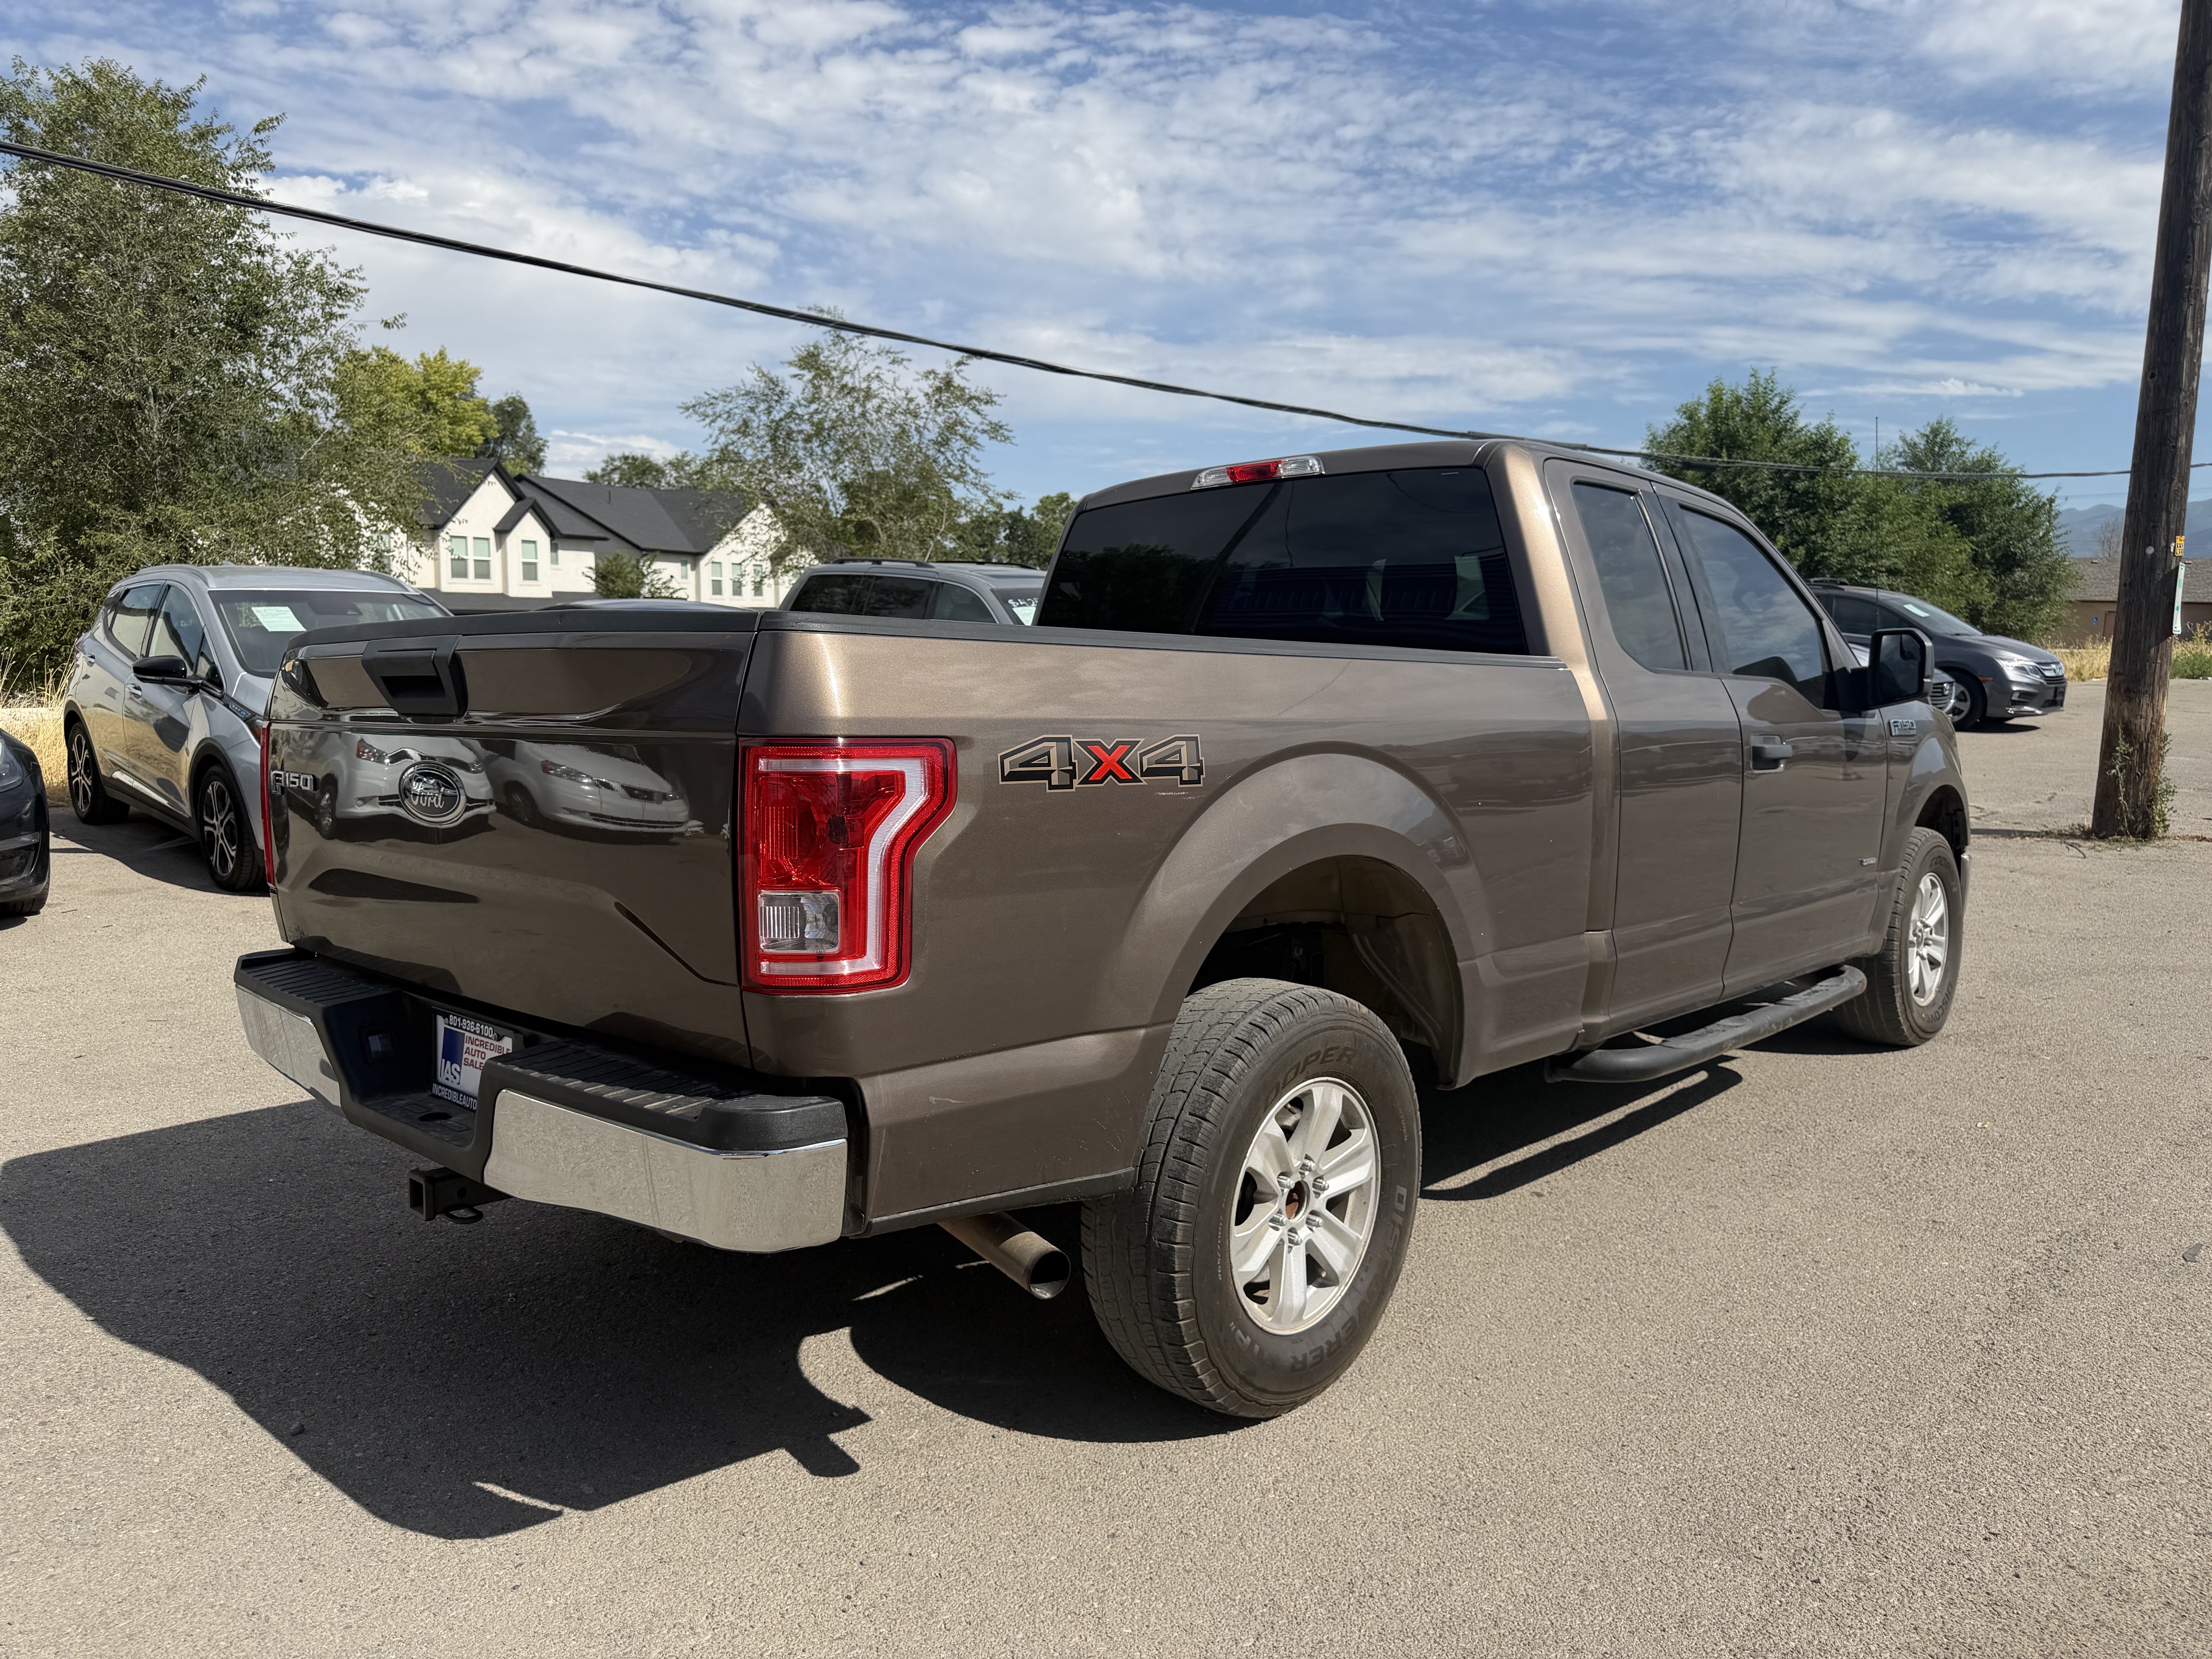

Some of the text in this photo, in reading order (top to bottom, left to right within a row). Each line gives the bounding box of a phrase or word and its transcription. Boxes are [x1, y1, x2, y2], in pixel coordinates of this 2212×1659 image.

[998, 734, 1205, 792] 4X4
[411, 774, 445, 809] Ford
[449, 1014, 493, 1037] 801-936-6100
[464, 1047, 486, 1060] AUTO
[441, 1058, 460, 1084] IAS
[432, 1083, 477, 1110] INCREDIBLEAUTO
